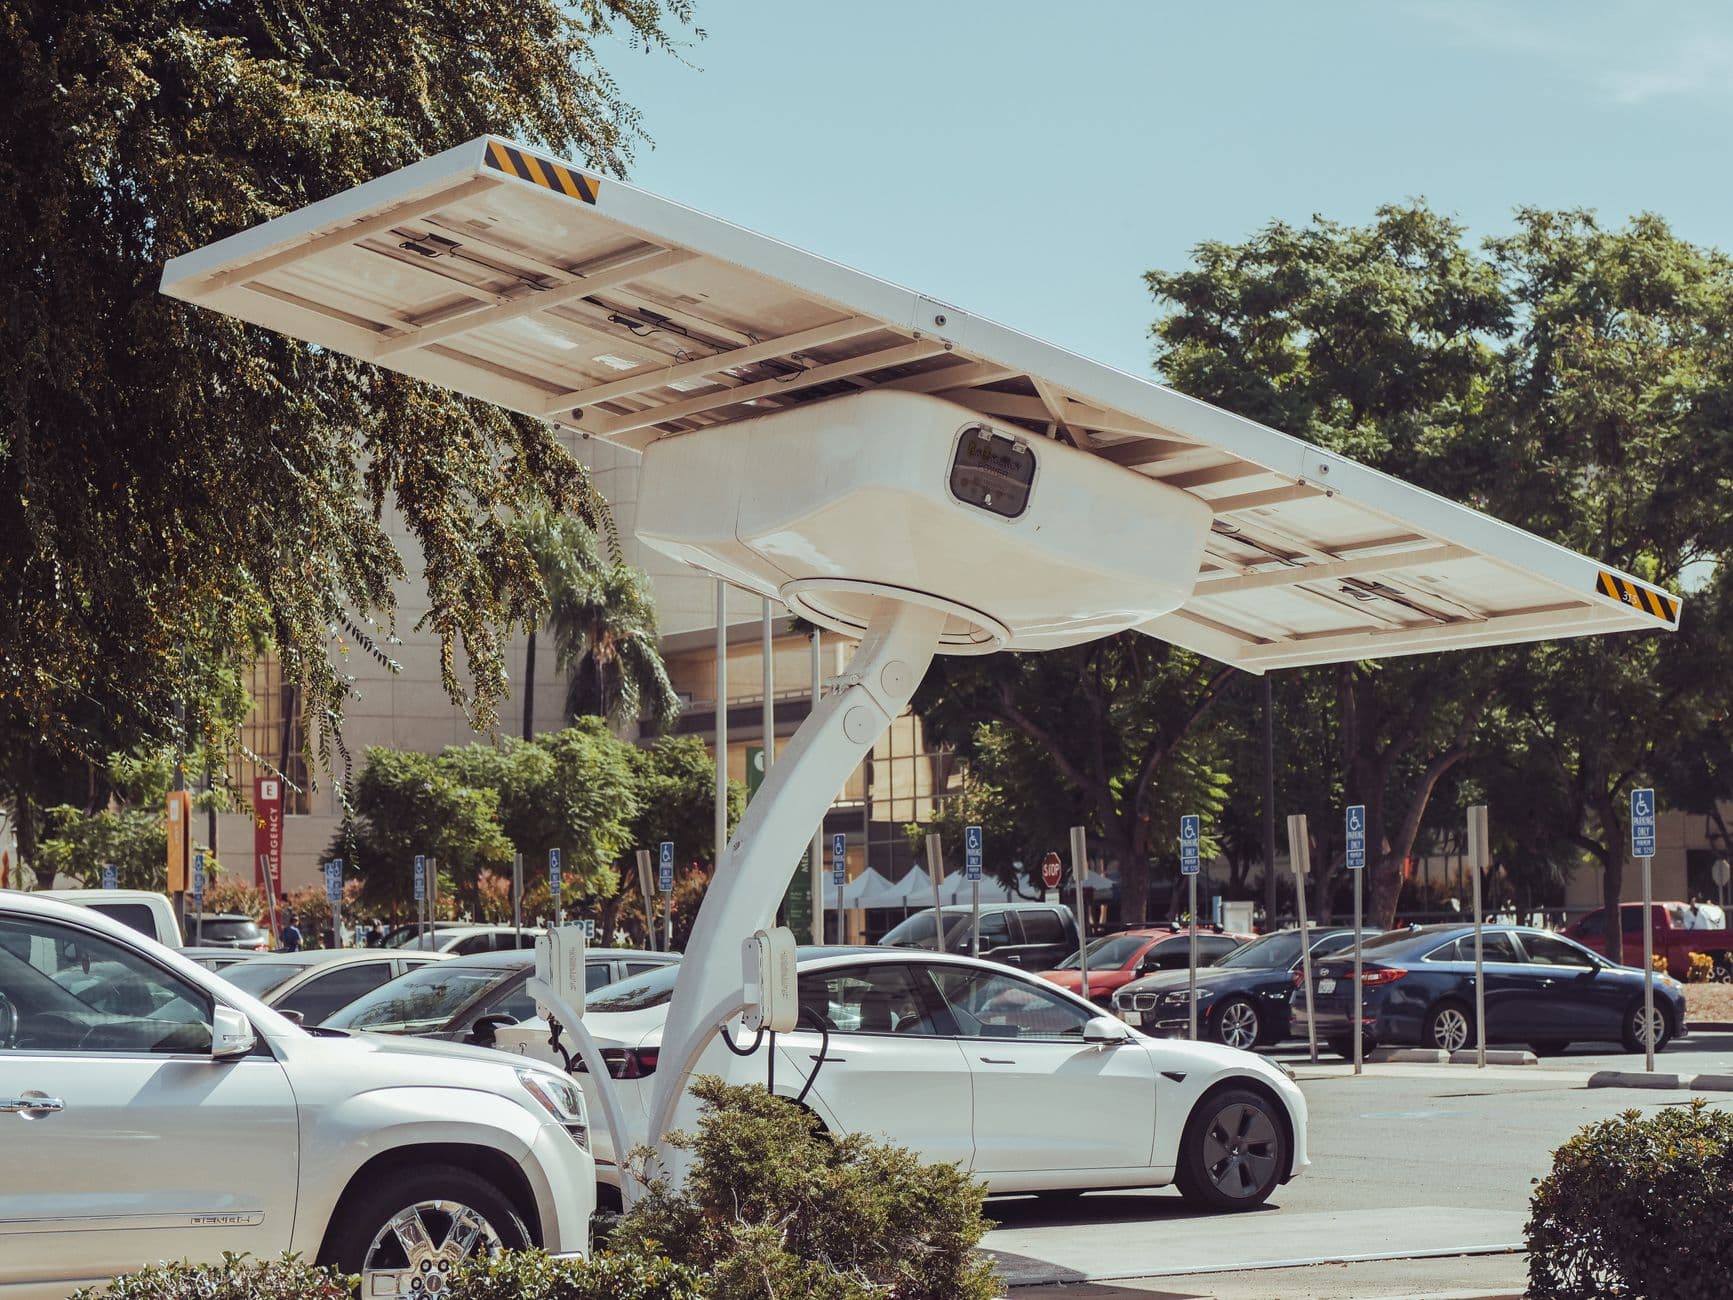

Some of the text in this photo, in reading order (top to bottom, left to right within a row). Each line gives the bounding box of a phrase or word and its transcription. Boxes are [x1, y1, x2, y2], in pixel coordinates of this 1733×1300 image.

[266, 785, 273, 796] E
[1633, 816, 1653, 826] PARKING
[1637, 827, 1649, 836] ONLY
[270, 807, 279, 880] EMERGENCY
[1044, 864, 1060, 877] STOP
